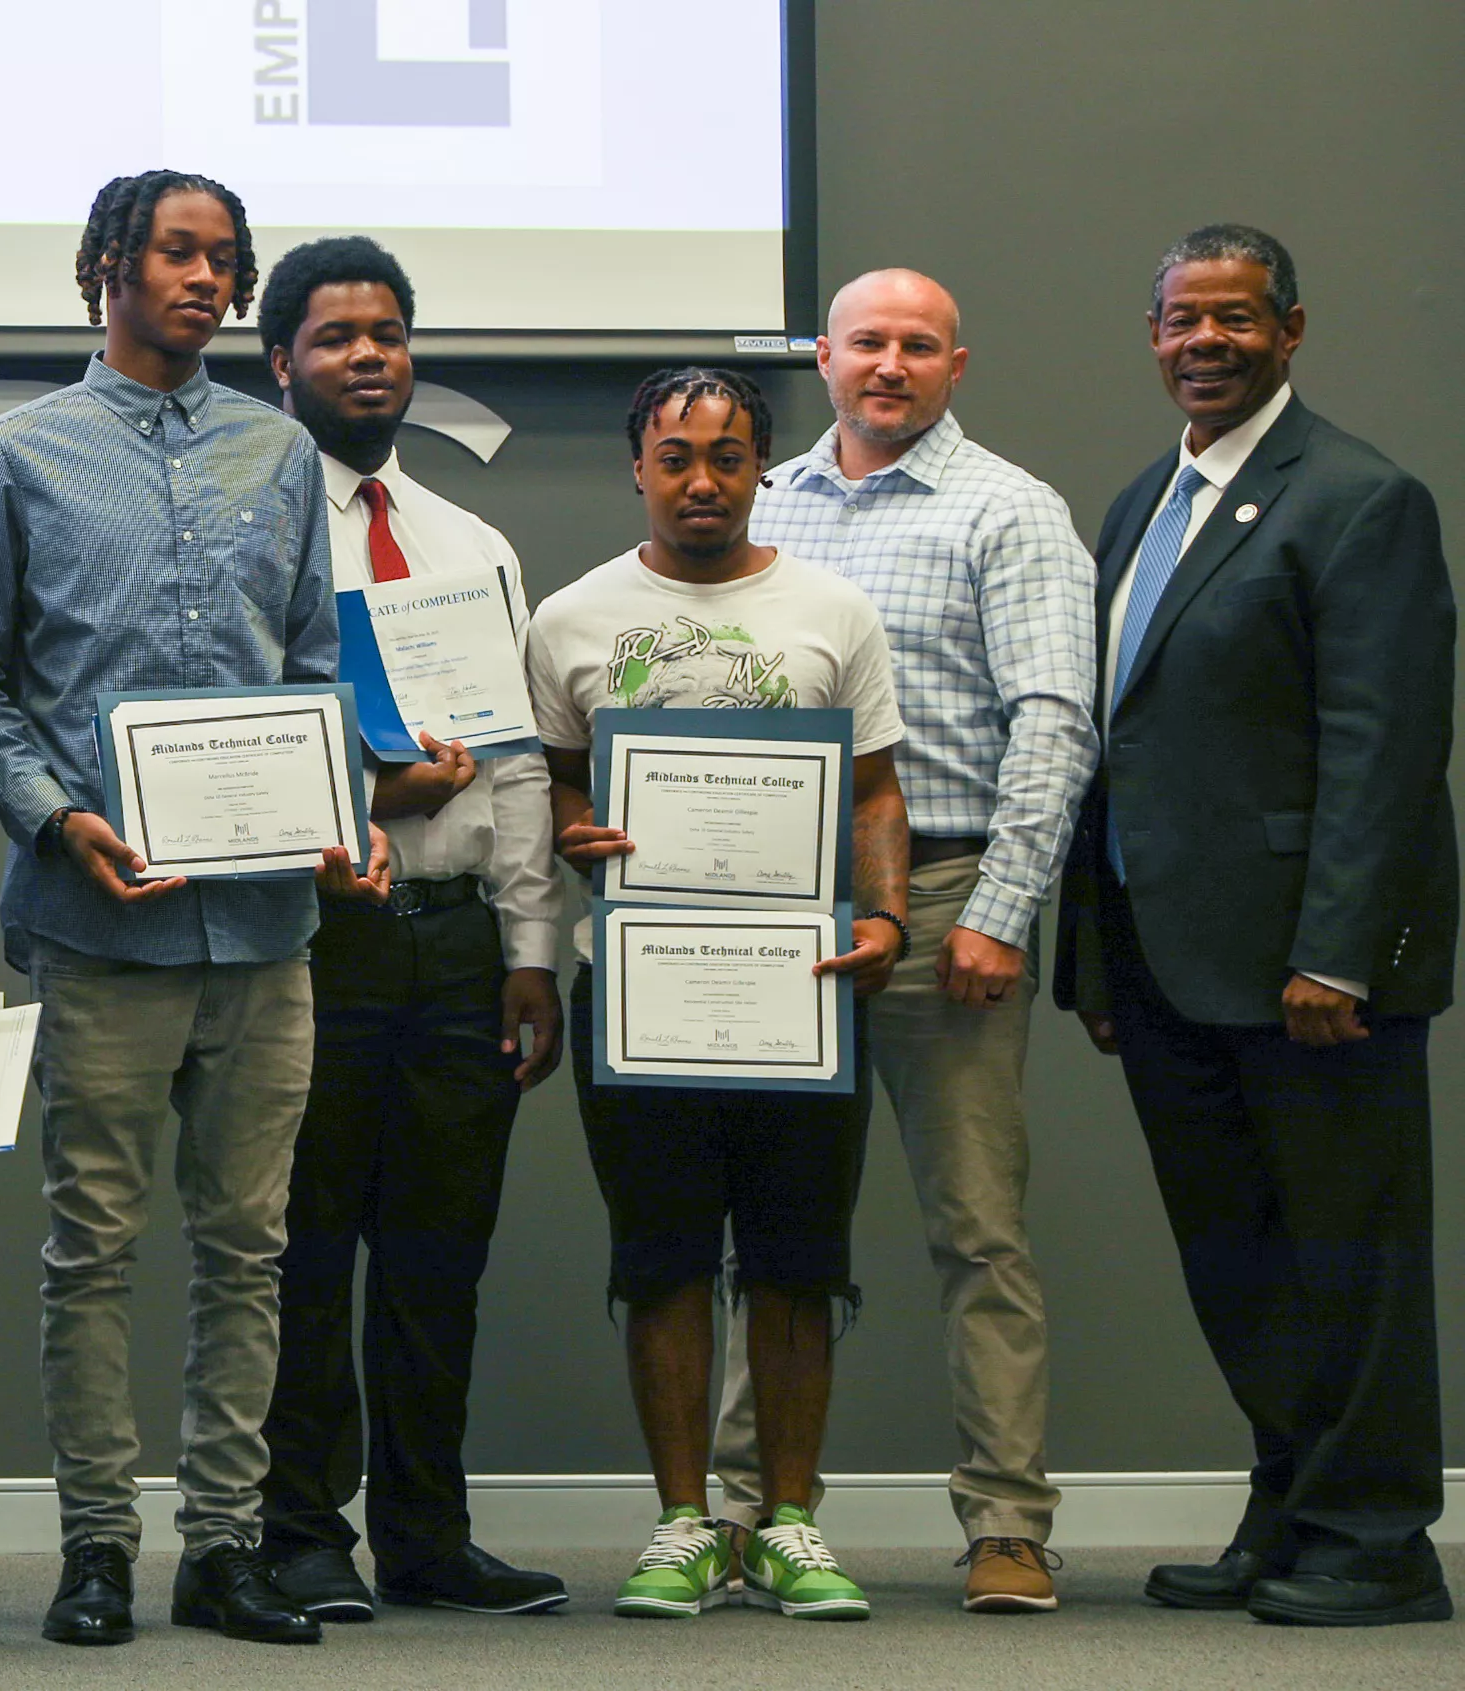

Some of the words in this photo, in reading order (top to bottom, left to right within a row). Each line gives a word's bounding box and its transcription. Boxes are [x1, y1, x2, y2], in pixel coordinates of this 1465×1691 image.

[401, 600, 413, 615] of
[412, 588, 489, 609] COMPLETION
[726, 652, 785, 695] MY
[151, 742, 204, 755] Midlands
[208, 736, 261, 749] Technical
[265, 733, 307, 744] College
[645, 771, 698, 783] Midlands
[704, 773, 756, 785] Technical
[761, 776, 804, 789] College
[641, 944, 694, 955] Midlands
[700, 945, 752, 956] Technical
[758, 946, 800, 958] College
